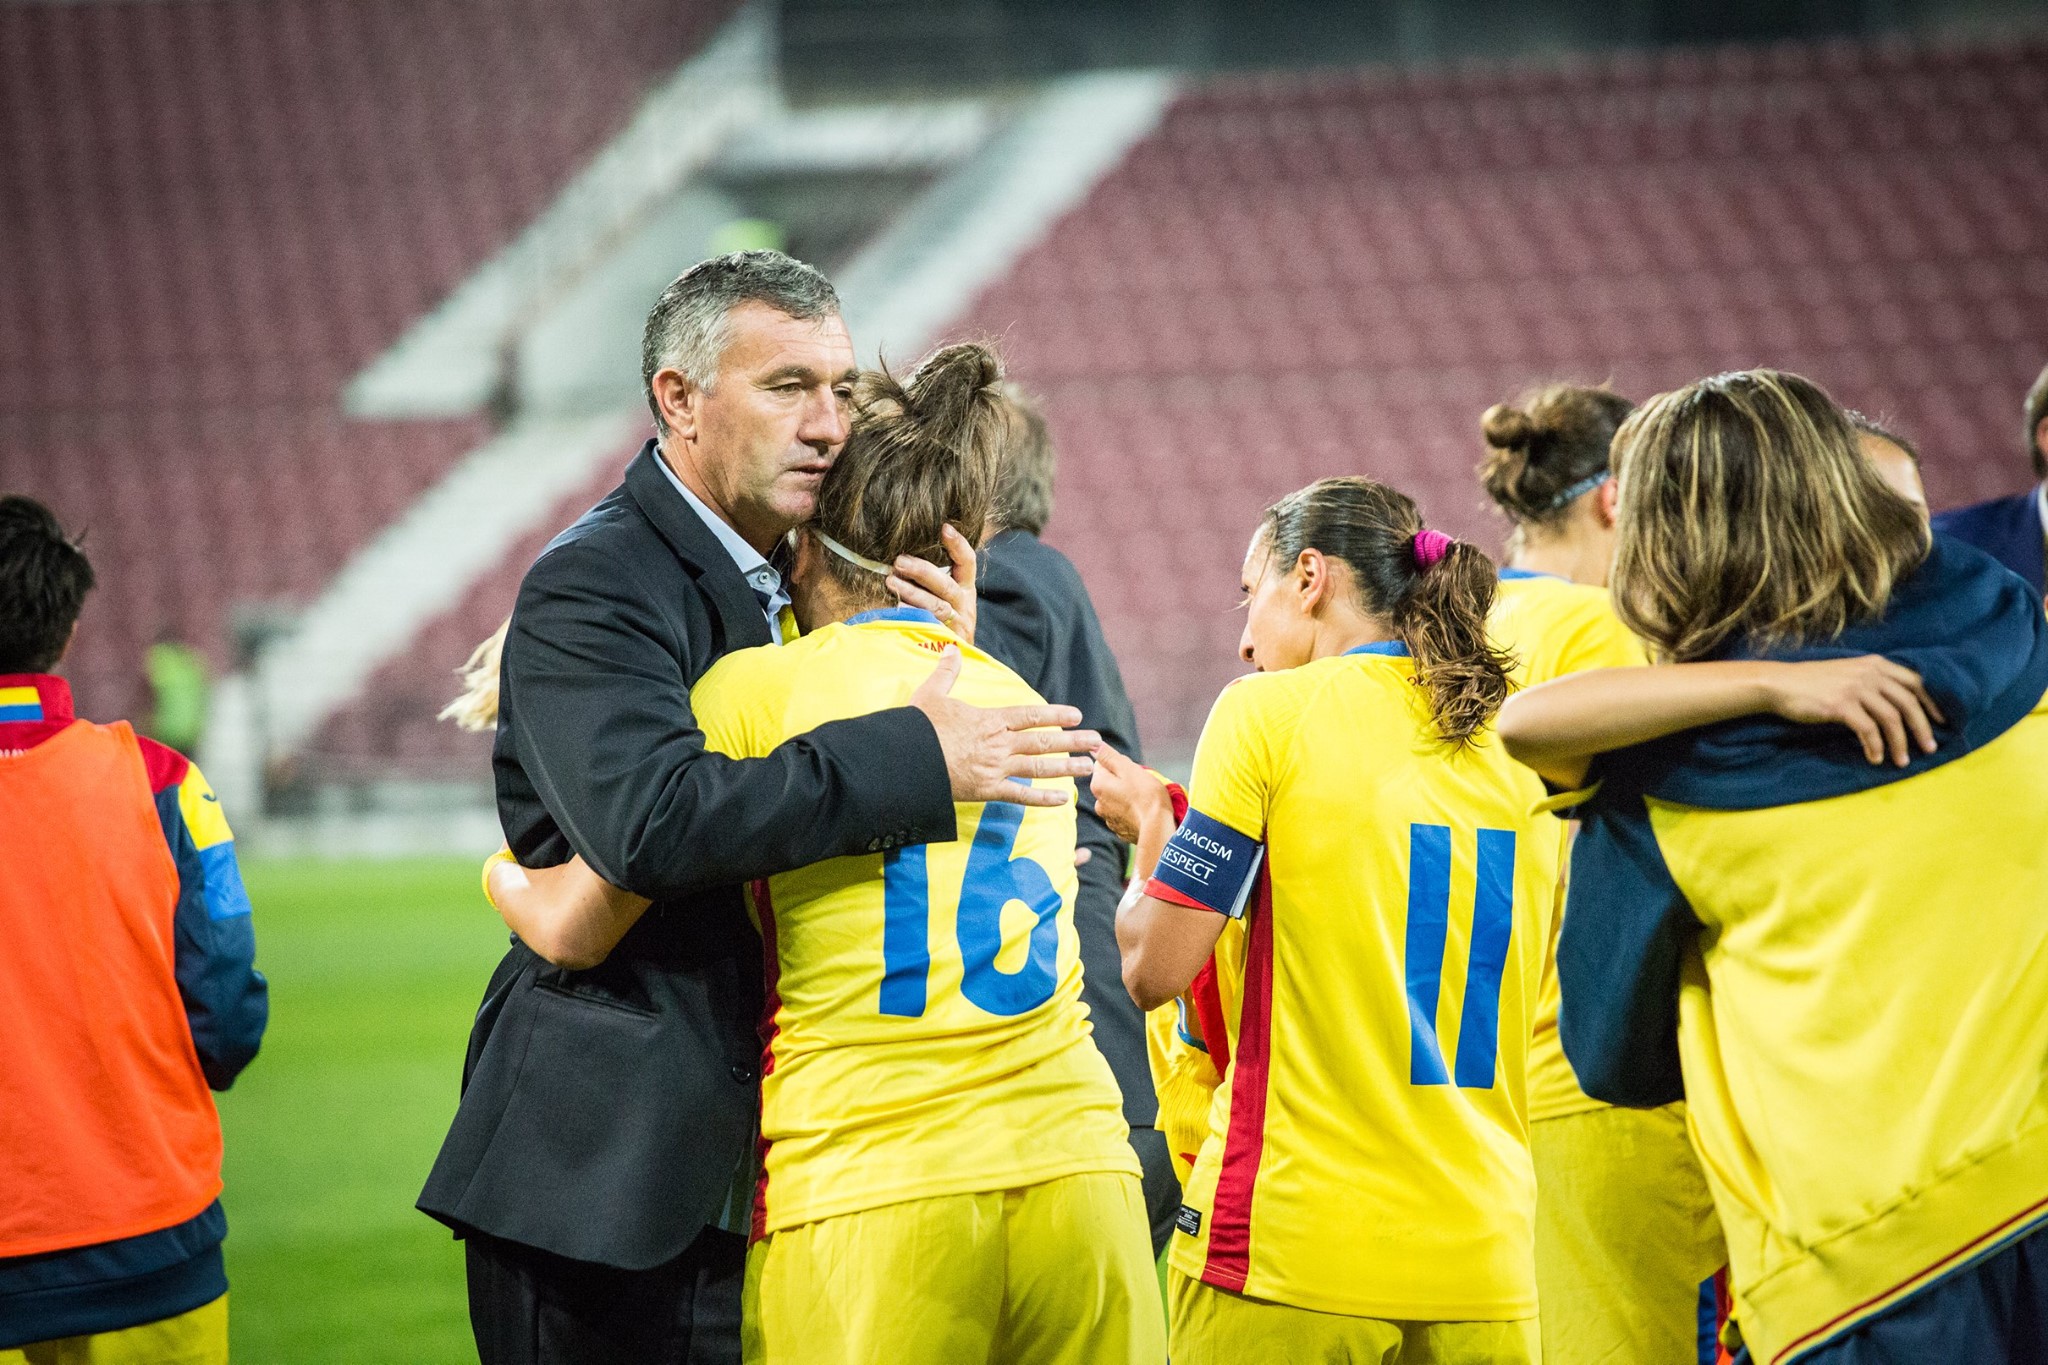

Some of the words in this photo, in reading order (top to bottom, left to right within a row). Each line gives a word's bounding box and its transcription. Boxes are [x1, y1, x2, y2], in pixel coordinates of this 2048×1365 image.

[879, 776, 1063, 1017] 16
[1162, 846, 1215, 880] RESPECT
[1176, 825, 1185, 836] O
[1182, 828, 1232, 860] RACISM
[1404, 823, 1516, 1090] 11
